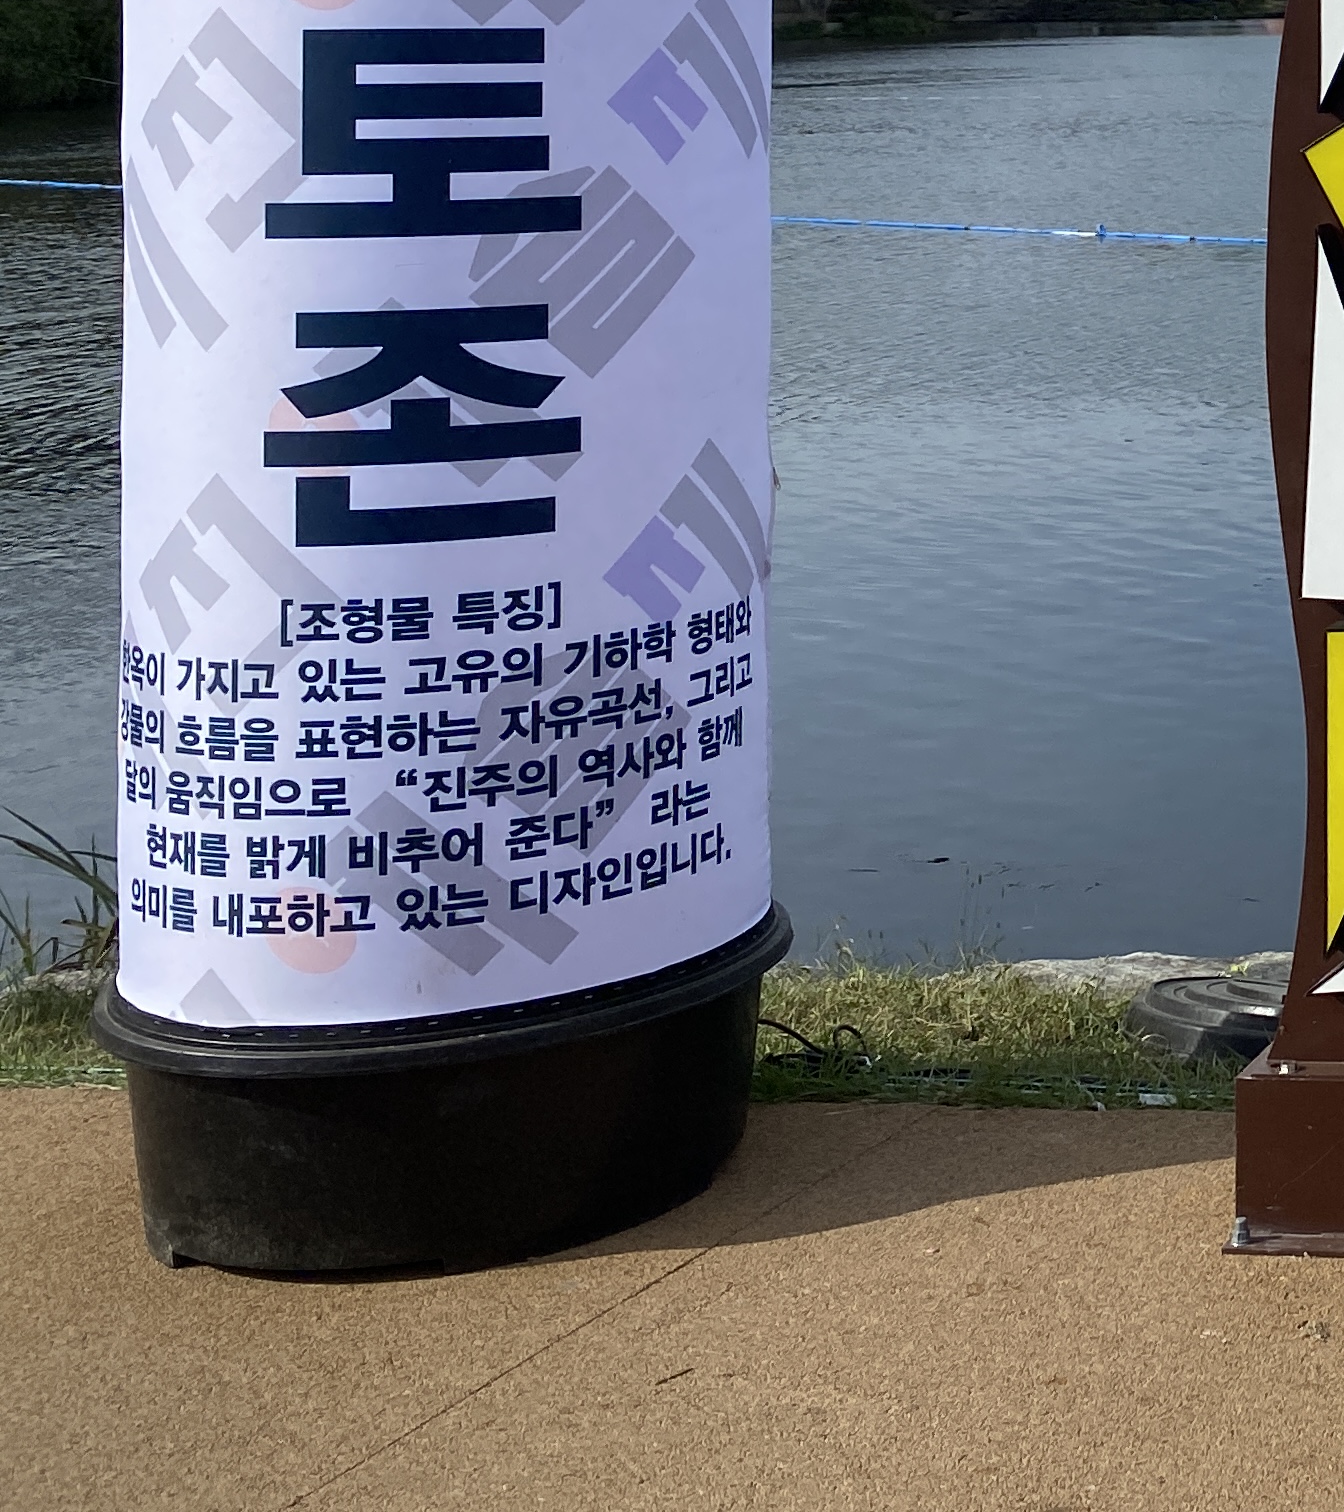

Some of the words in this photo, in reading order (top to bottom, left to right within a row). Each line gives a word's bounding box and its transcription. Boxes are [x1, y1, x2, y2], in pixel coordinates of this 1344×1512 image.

[177, 658, 278, 702] 가지고
[299, 659, 386, 702] 있는
[404, 643, 542, 694] 고유의
[564, 620, 676, 678] 기하학
[687, 594, 751, 654] 형태와
[281, 597, 434, 647] [조형물
[452, 581, 561, 634] 특징]
[122, 699, 164, 753] 강물의
[176, 716, 278, 761] 흐름을
[296, 711, 481, 759] 표현하는
[498, 678, 673, 744] 자유곡선,
[687, 653, 752, 707] 그리고
[126, 759, 155, 809] 달의
[166, 771, 351, 820] 움직임으로
[578, 727, 687, 788] 역사와
[698, 706, 742, 761] 함께
[132, 879, 197, 932] 의미를
[213, 894, 375, 937] 내포하고
[396, 884, 489, 932] 있는
[508, 823, 732, 916] 디자인입니다.
[147, 824, 230, 877] 현재를
[247, 835, 325, 879] 밝게
[349, 822, 483, 876] 비추어
[651, 780, 710, 826] 라는
